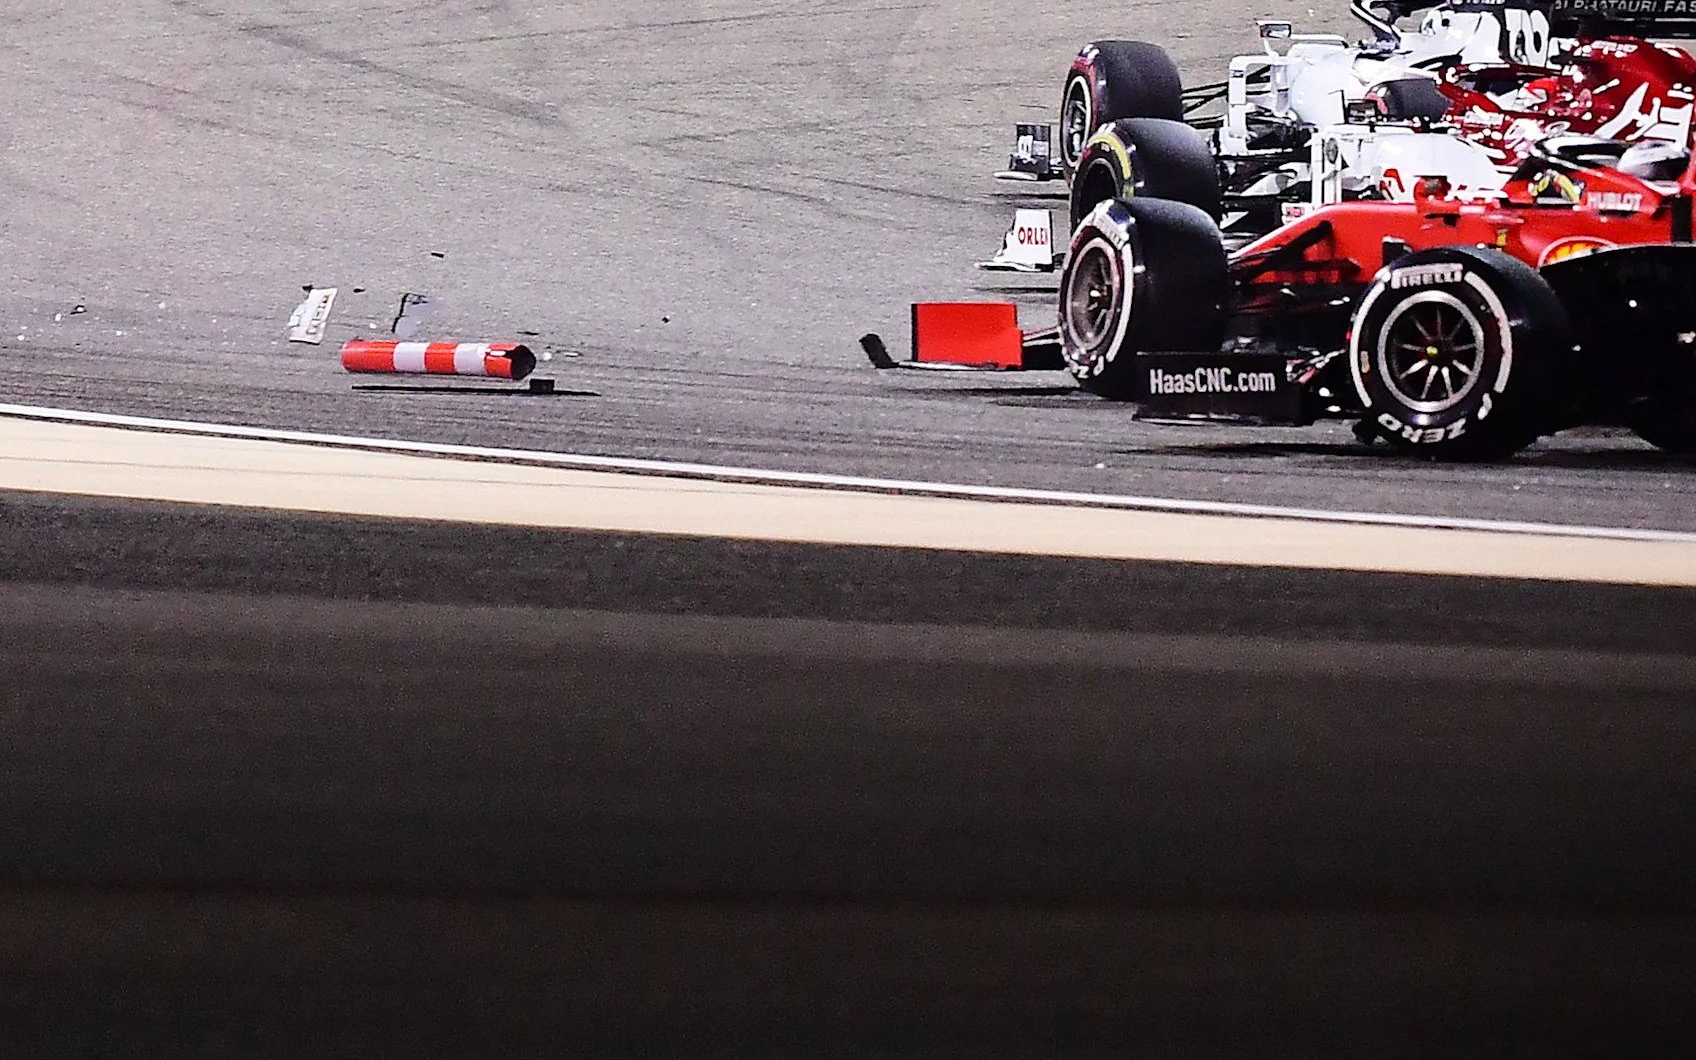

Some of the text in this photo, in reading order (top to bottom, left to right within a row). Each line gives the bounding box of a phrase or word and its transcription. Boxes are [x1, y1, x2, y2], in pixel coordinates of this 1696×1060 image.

[1390, 263, 1464, 290] PIRELLI
[1149, 367, 1276, 394] HaasCNC.com
[1377, 412, 1467, 444] ZERO
